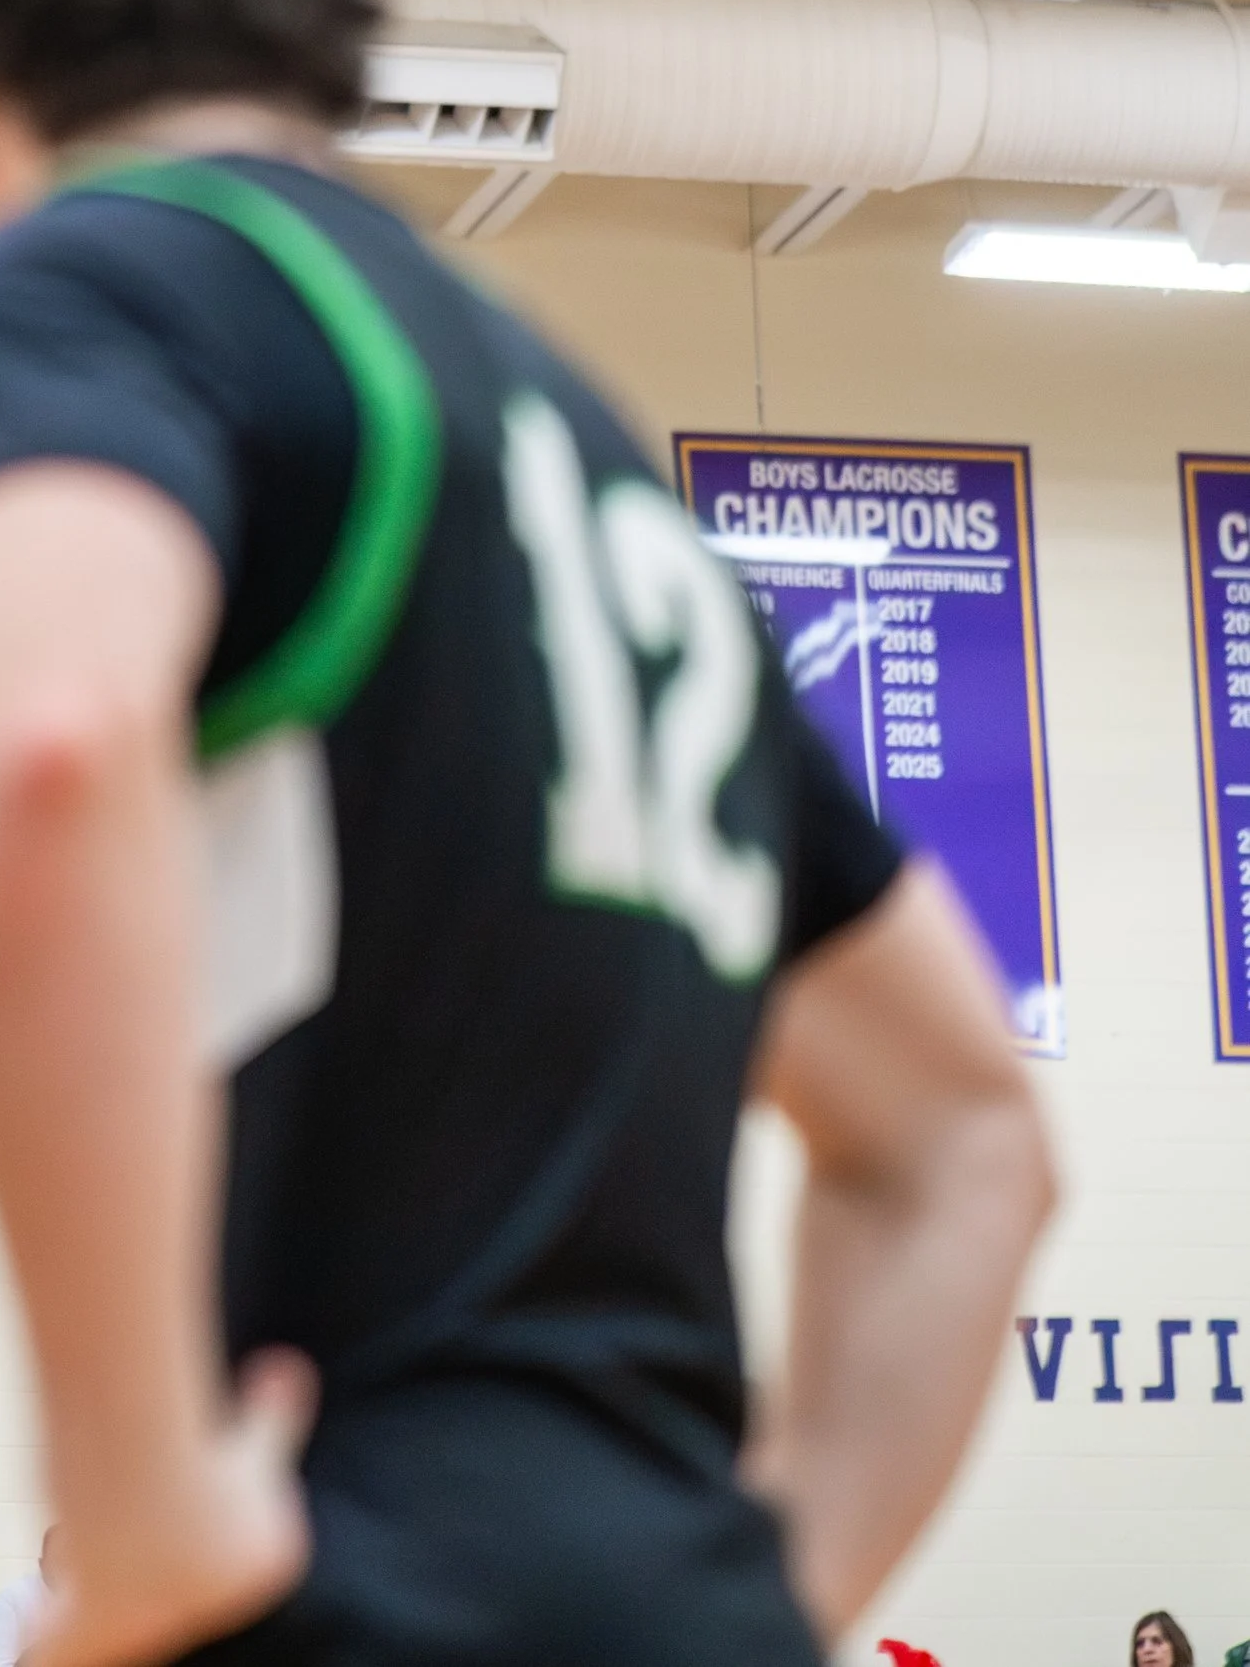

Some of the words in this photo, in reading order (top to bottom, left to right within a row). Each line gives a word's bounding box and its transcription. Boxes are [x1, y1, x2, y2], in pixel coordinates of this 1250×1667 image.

[749, 460, 818, 490] BOYS
[824, 463, 959, 495] LACROSSE
[714, 492, 1000, 552] CHAMPIONS
[868, 567, 1004, 595] QUARTERFINALS
[878, 597, 934, 623] 2017
[880, 627, 937, 654] 2018
[881, 658, 939, 685] 2019
[882, 690, 936, 717] 2021
[884, 721, 941, 748] 2024
[887, 752, 945, 780] 2025
